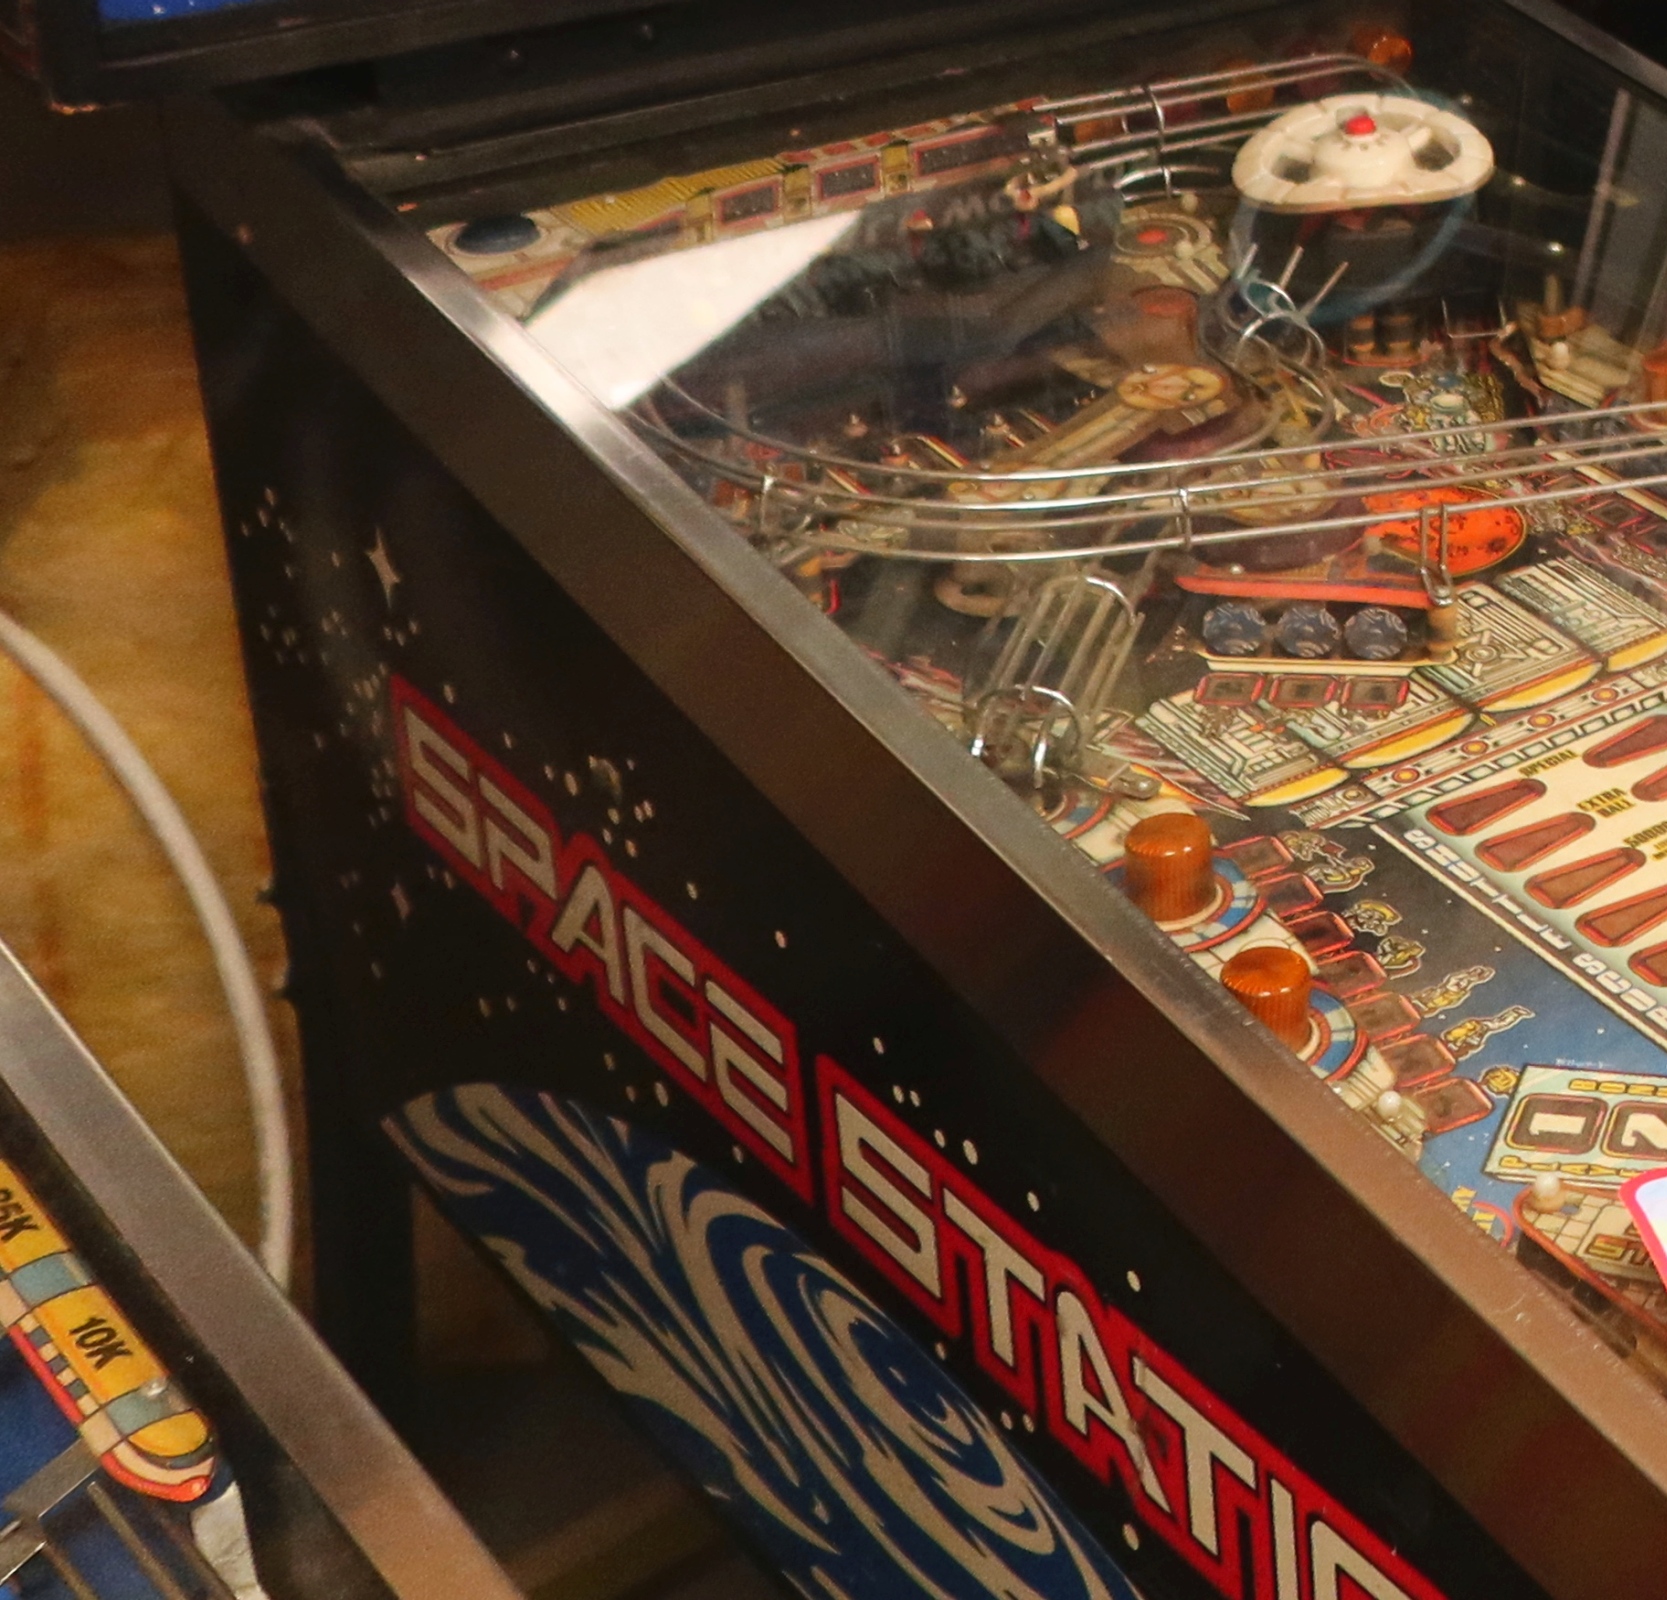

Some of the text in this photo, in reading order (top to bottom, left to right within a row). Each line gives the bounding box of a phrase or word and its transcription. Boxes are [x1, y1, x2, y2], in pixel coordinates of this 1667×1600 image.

[1577, 787, 1628, 812] EXTRA
[1404, 828, 1571, 950] SHUTTLE
[404, 703, 796, 1164] SPACE
[68, 1317, 134, 1372] 10K
